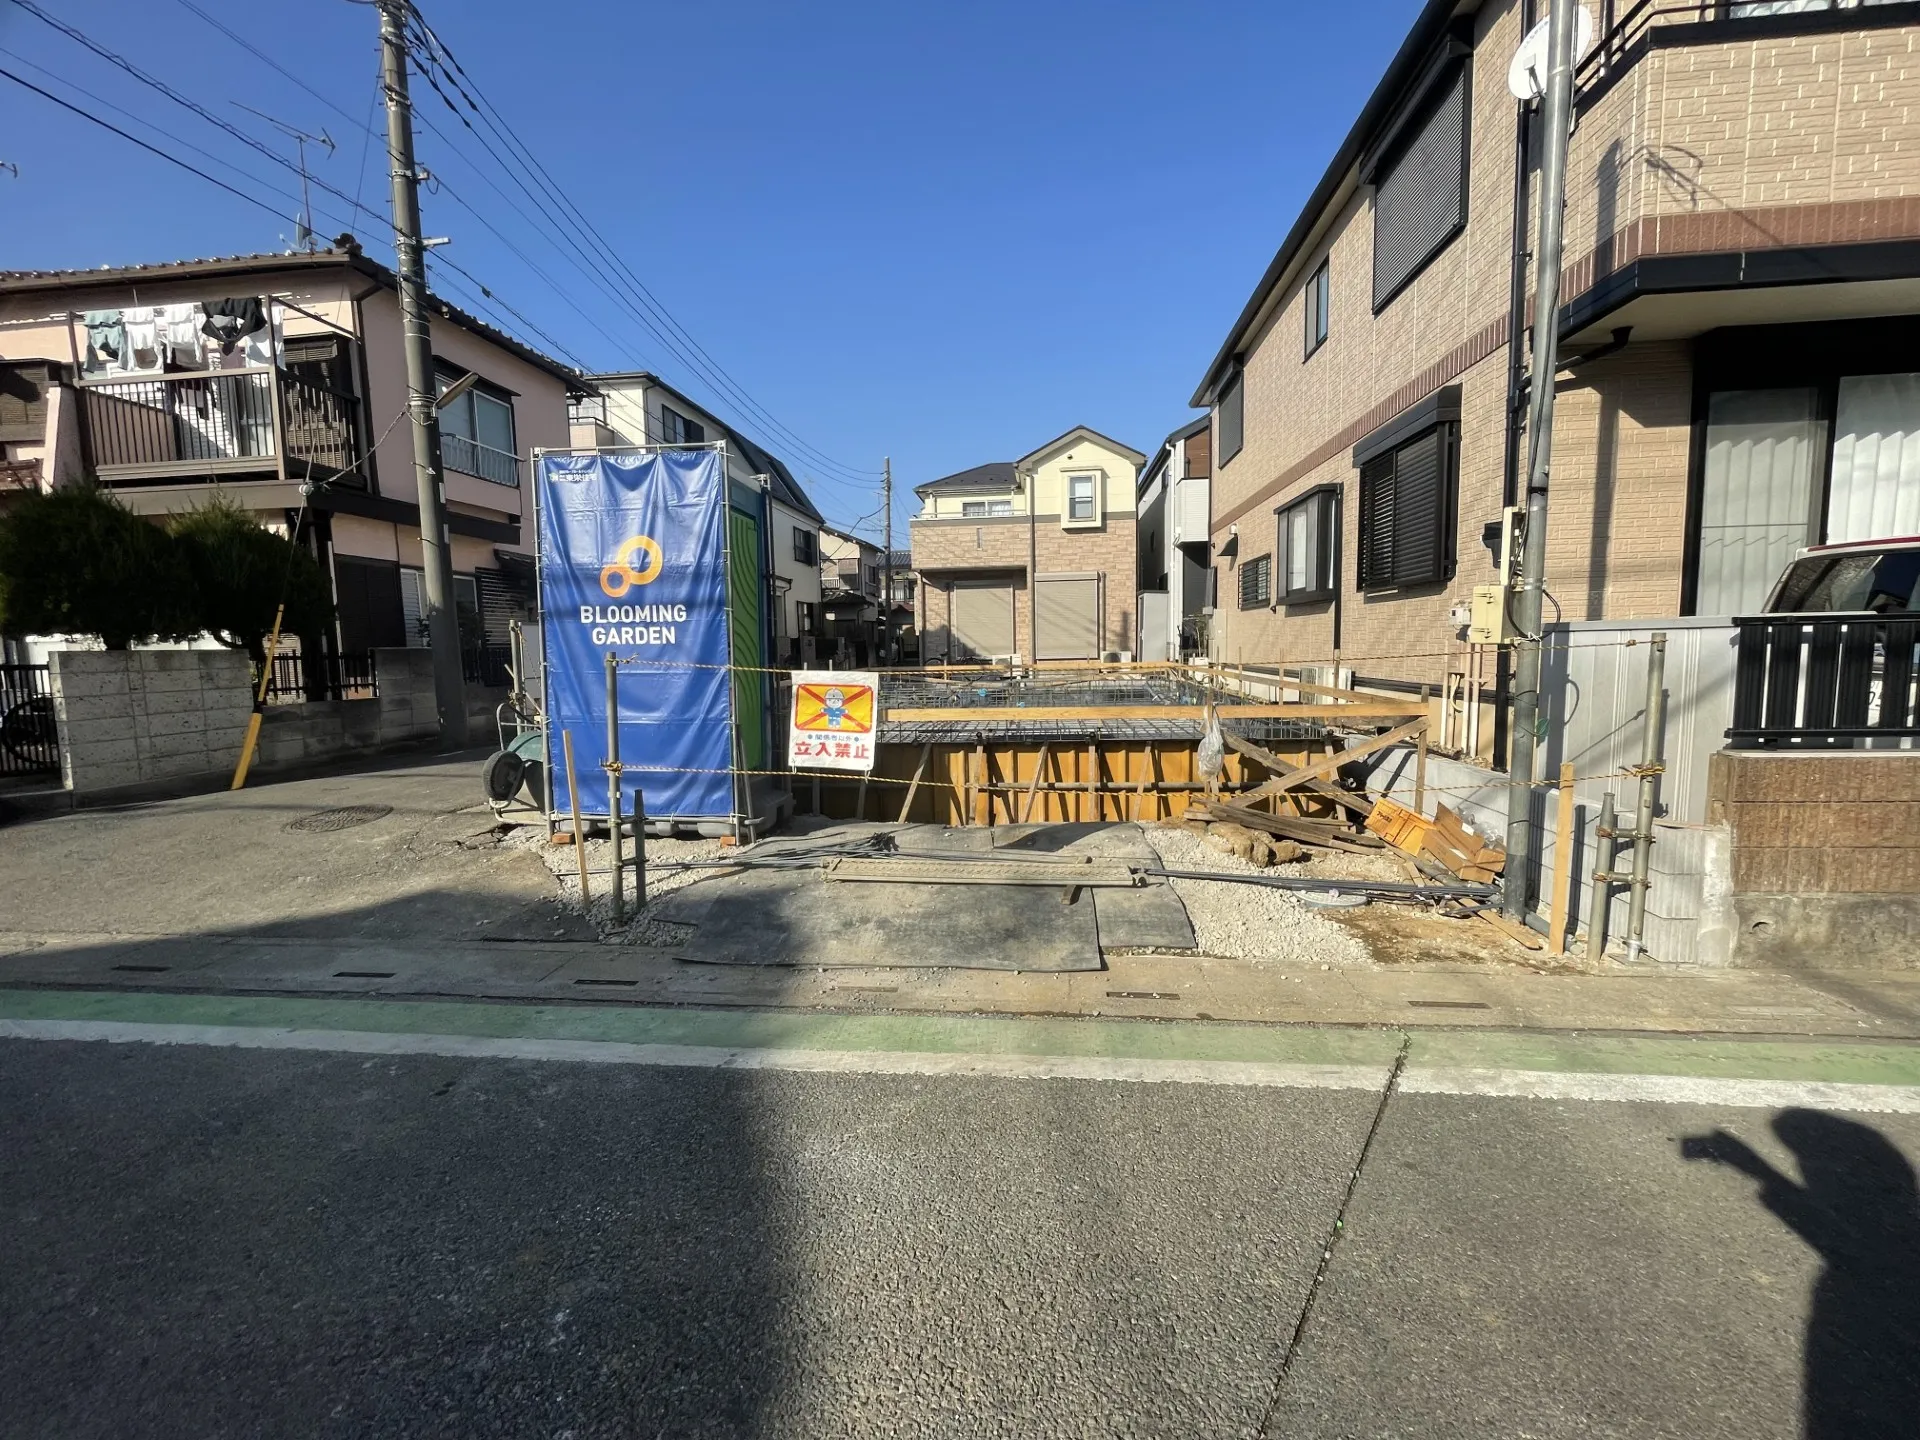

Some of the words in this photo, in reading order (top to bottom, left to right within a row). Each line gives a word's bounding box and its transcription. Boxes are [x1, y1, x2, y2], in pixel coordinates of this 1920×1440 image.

[580, 604, 687, 624] BLOOMING
[592, 625, 675, 645] GARDEN
[794, 741, 869, 760] 立入禁止
